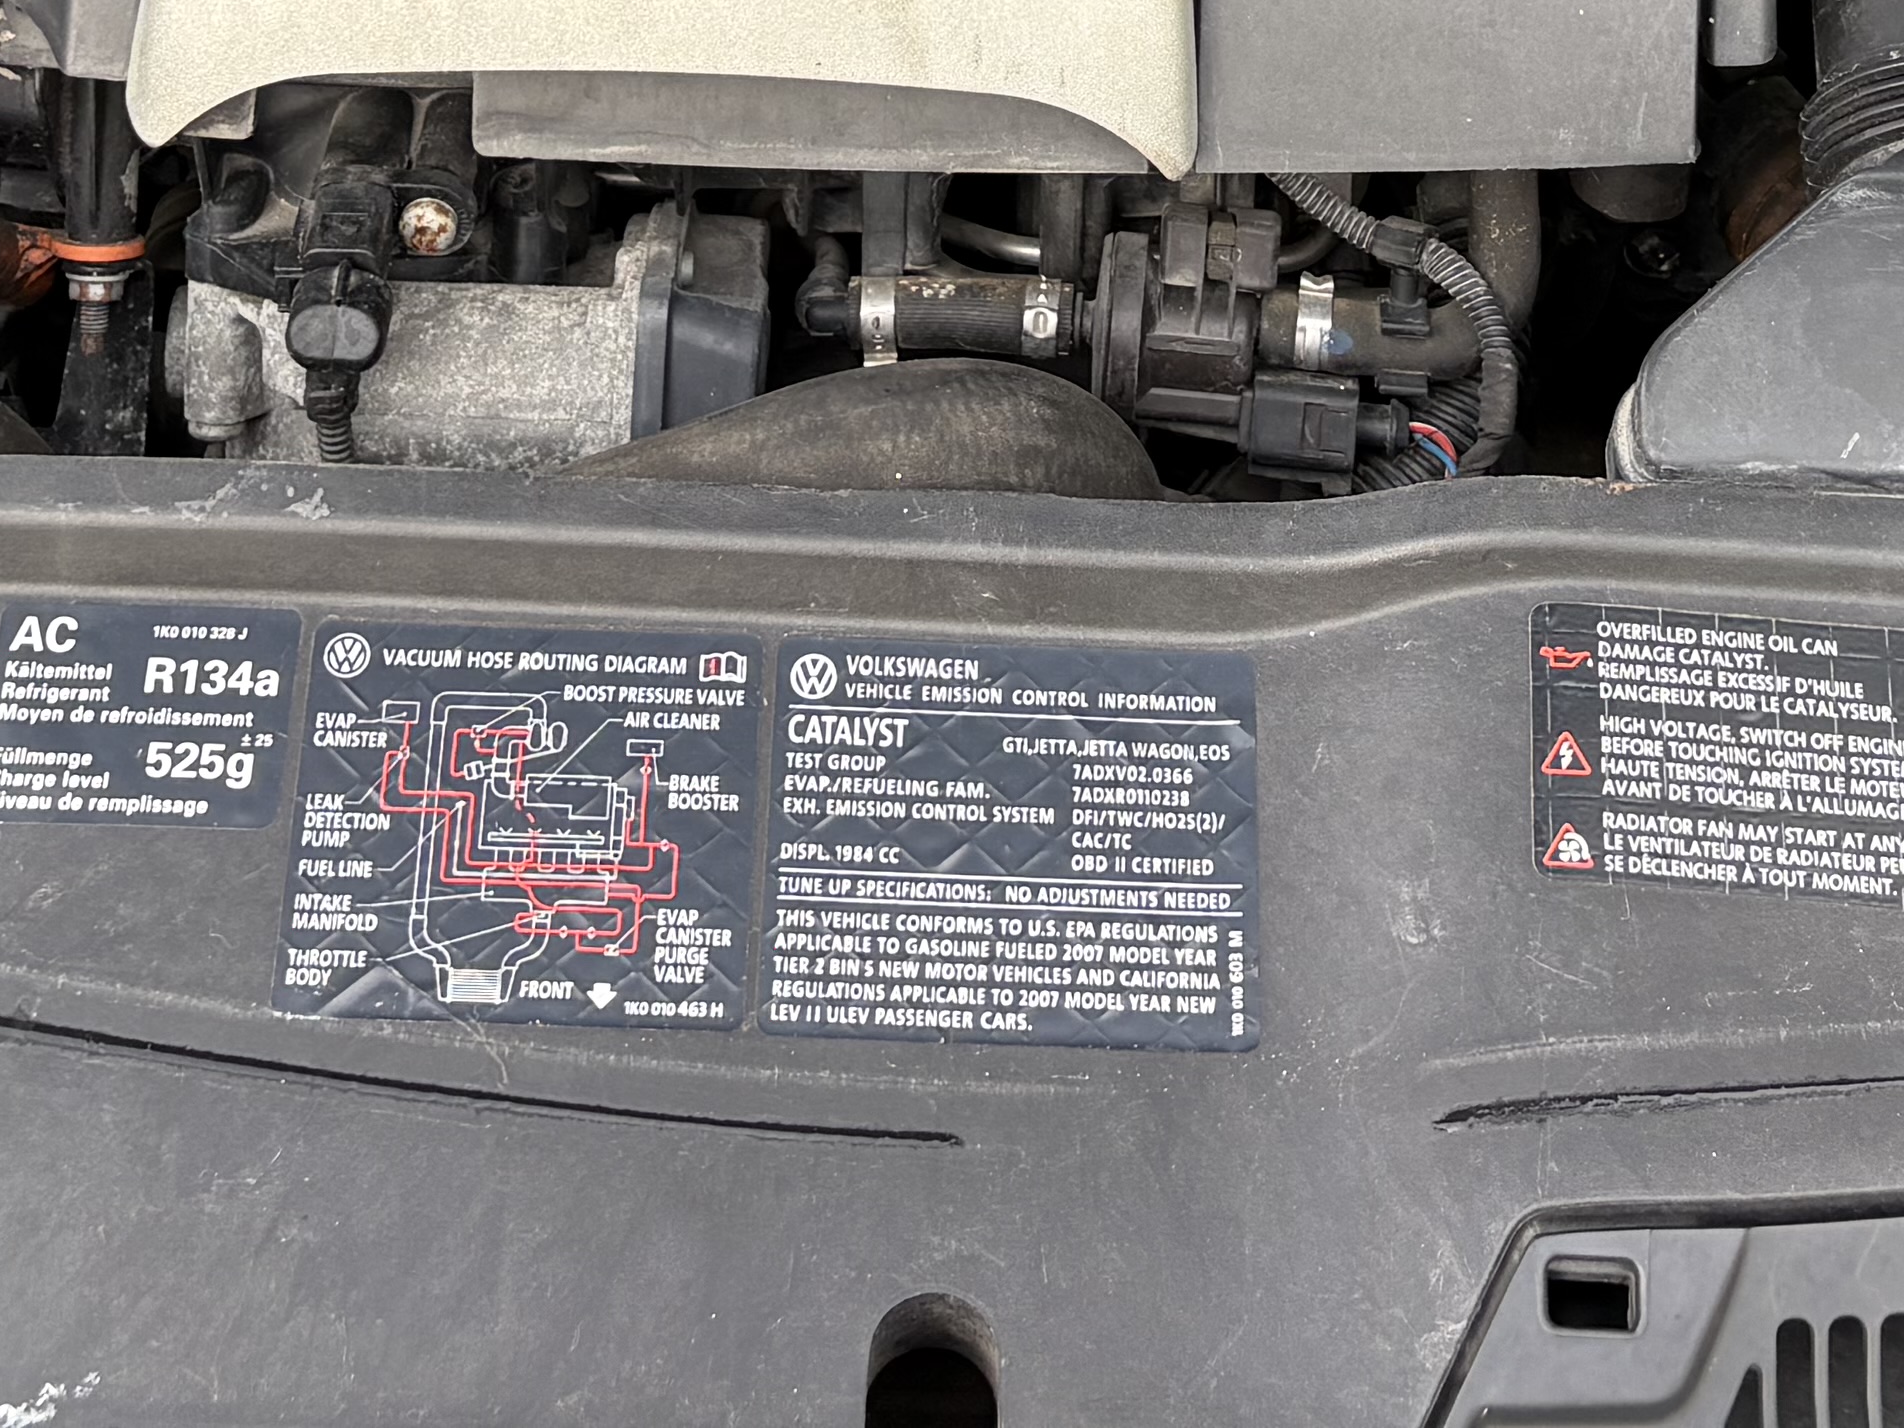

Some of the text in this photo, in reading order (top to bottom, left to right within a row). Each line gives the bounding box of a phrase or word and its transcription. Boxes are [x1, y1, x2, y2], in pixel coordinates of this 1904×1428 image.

[9, 615, 79, 653] AC
[181, 626, 208, 639] 010
[238, 627, 248, 641] J
[1597, 621, 1838, 656] OVERFILLED ENGINE OIL CAN
[383, 648, 687, 675] VACUUM HOSE ROUTING DIAGRAM
[1598, 641, 1769, 670] DAMAGE CATALYST.
[5, 660, 112, 681] Kältemittel
[144, 656, 280, 696] R134a
[846, 654, 979, 680] VOLKSWAGEN
[1598, 661, 1864, 699] REMPLISSAGE EXCESSIF D'HUILE
[1, 682, 110, 703] Refrigerant
[563, 684, 746, 707] BOOST PRESSURE VALVE
[845, 683, 1216, 712] VEHICLE EMISSION CONTROL INFORMATION
[1600, 682, 1898, 723] DANGEREUX POUR LE CATALYSEUR.
[70, 705, 94, 723] de
[100, 707, 254, 727] refroidissement
[315, 712, 357, 729] EVAP
[623, 711, 721, 731] AIR CLEANER
[254, 733, 273, 747] 25
[313, 730, 388, 749] CANISTER
[788, 714, 909, 748] CATALYST
[1600, 715, 1646, 734] HIGH
[1740, 727, 1806, 748] SWITCH
[1810, 732, 1843, 751] OFF
[145, 741, 254, 789] 525g
[785, 752, 887, 771] TEST GROUP
[1601, 736, 1664, 757] BEFORE
[1668, 741, 1761, 767] TOUCHING
[1765, 749, 1845, 773] IGNITION
[63, 771, 110, 790] level
[669, 774, 720, 792] BRAKE
[1073, 763, 1193, 784] 7ADXV02.0366
[784, 775, 990, 799] EVAP./REFUELING FAM.
[1072, 786, 1190, 807] 7ADXR0110238
[58, 792, 83, 811] de
[88, 795, 209, 818] remplissage
[305, 793, 345, 811] LEAK
[667, 793, 740, 812] BOOSTER
[783, 797, 1055, 825] EXH. EMISSION CONTROL SYSTEM
[303, 812, 390, 830] DETECTION
[1602, 811, 1693, 835] RADIATOR
[1698, 819, 1734, 839] FAN
[1738, 823, 1779, 843] MAY
[1785, 827, 1837, 847] START
[1842, 832, 1865, 850] AT
[301, 830, 350, 848] PUMP
[1071, 831, 1132, 850] CAC/TC
[780, 842, 901, 864] DISPL. 1984 CC
[1603, 832, 1624, 851] LE
[1628, 835, 1745, 861] VENTILATEUR
[1750, 845, 1773, 864] DE
[1776, 848, 1876, 872] RADIATEUR
[298, 859, 373, 878] FUEL LINE
[1071, 854, 1108, 872] OBD
[1131, 856, 1214, 876] CERTIFIED
[294, 893, 352, 912] INTAKE
[779, 876, 1231, 910] TUNE UP SPECIFICATIONS: NO ADJUSTMENTS NEEDED
[292, 912, 378, 931] MANIFOLD
[656, 908, 699, 926] EVAP
[776, 908, 1218, 943] THIS VEHICLE CONFORMS TO U.S. EPA REGULATIONS
[655, 927, 731, 947] CANISTER
[1228, 930, 1243, 948] M
[287, 948, 368, 968] THROTTLE
[654, 946, 709, 965] PURGE
[774, 933, 1217, 967] APPLICABLE TO GASOLINE FUELED 2007 MODEL YEAR
[285, 968, 332, 986] BODY
[653, 965, 705, 984] VALVE
[1229, 952, 1244, 982] 603
[519, 980, 574, 999] FRONT
[1231, 986, 1244, 1009] 010
[623, 1001, 724, 1018] 1K0 010 463 H
[770, 1003, 800, 1022] LEV
[826, 1005, 869, 1025] ULEV
[875, 1008, 973, 1029] PASSENGER
[980, 1011, 1032, 1031] CARS.
